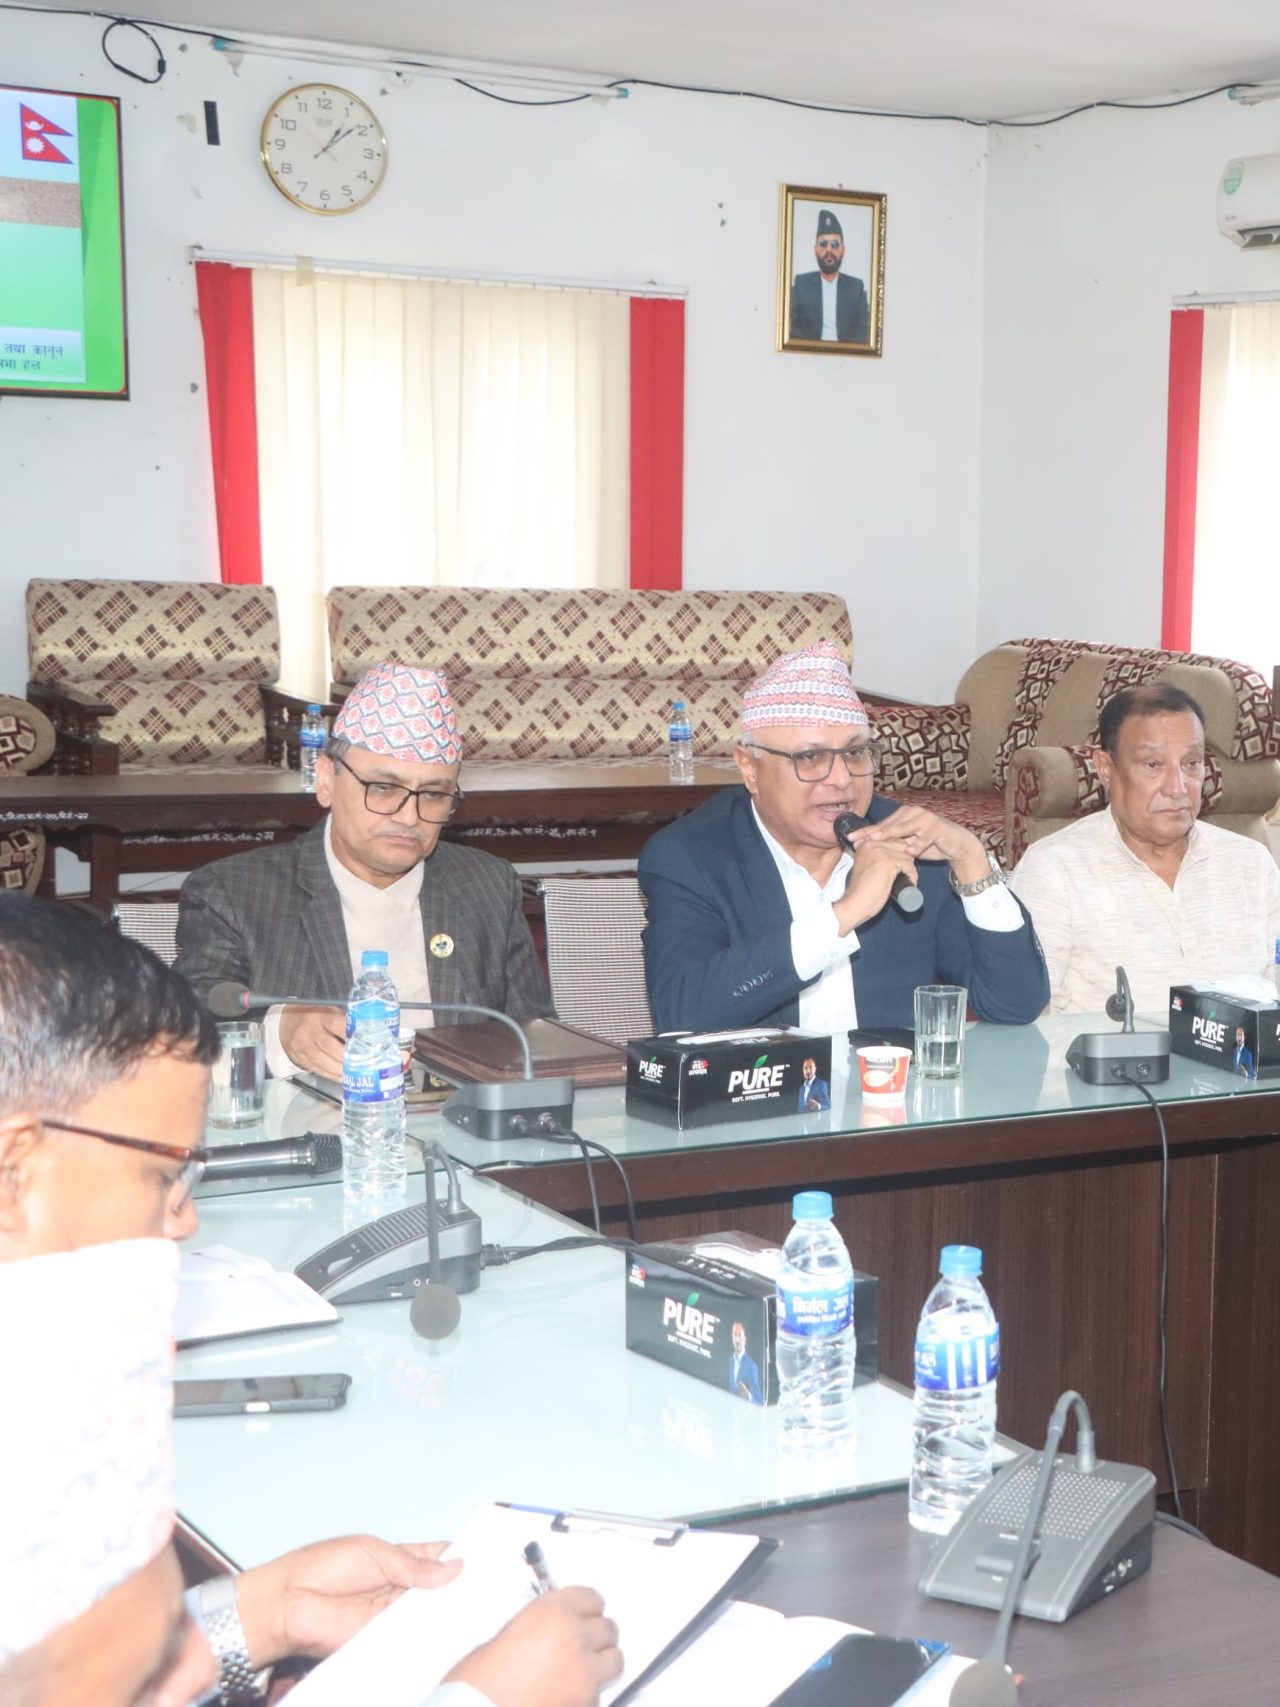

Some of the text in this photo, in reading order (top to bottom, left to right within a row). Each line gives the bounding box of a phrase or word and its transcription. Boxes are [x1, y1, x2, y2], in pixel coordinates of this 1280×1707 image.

[298, 102, 308, 113] 11
[317, 98, 332, 110] 12
[344, 107, 350, 118] 1
[280, 118, 297, 131] 10
[357, 125, 368, 136] 2
[275, 139, 286, 150] 9
[363, 148, 374, 160] 3
[280, 162, 292, 174] 8
[357, 171, 368, 180] 4
[297, 181, 308, 192] 7
[341, 185, 352, 196] 5
[320, 189, 331, 201] 6
[4, 344, 26, 354] तथा
[23, 360, 41, 371] हल
[1192, 1016, 1226, 1043] PURE
[639, 1060, 664, 1078] PURE
[356, 1075, 374, 1088] JAL
[728, 1065, 786, 1093] PURE
[663, 1297, 715, 1344] PURE
